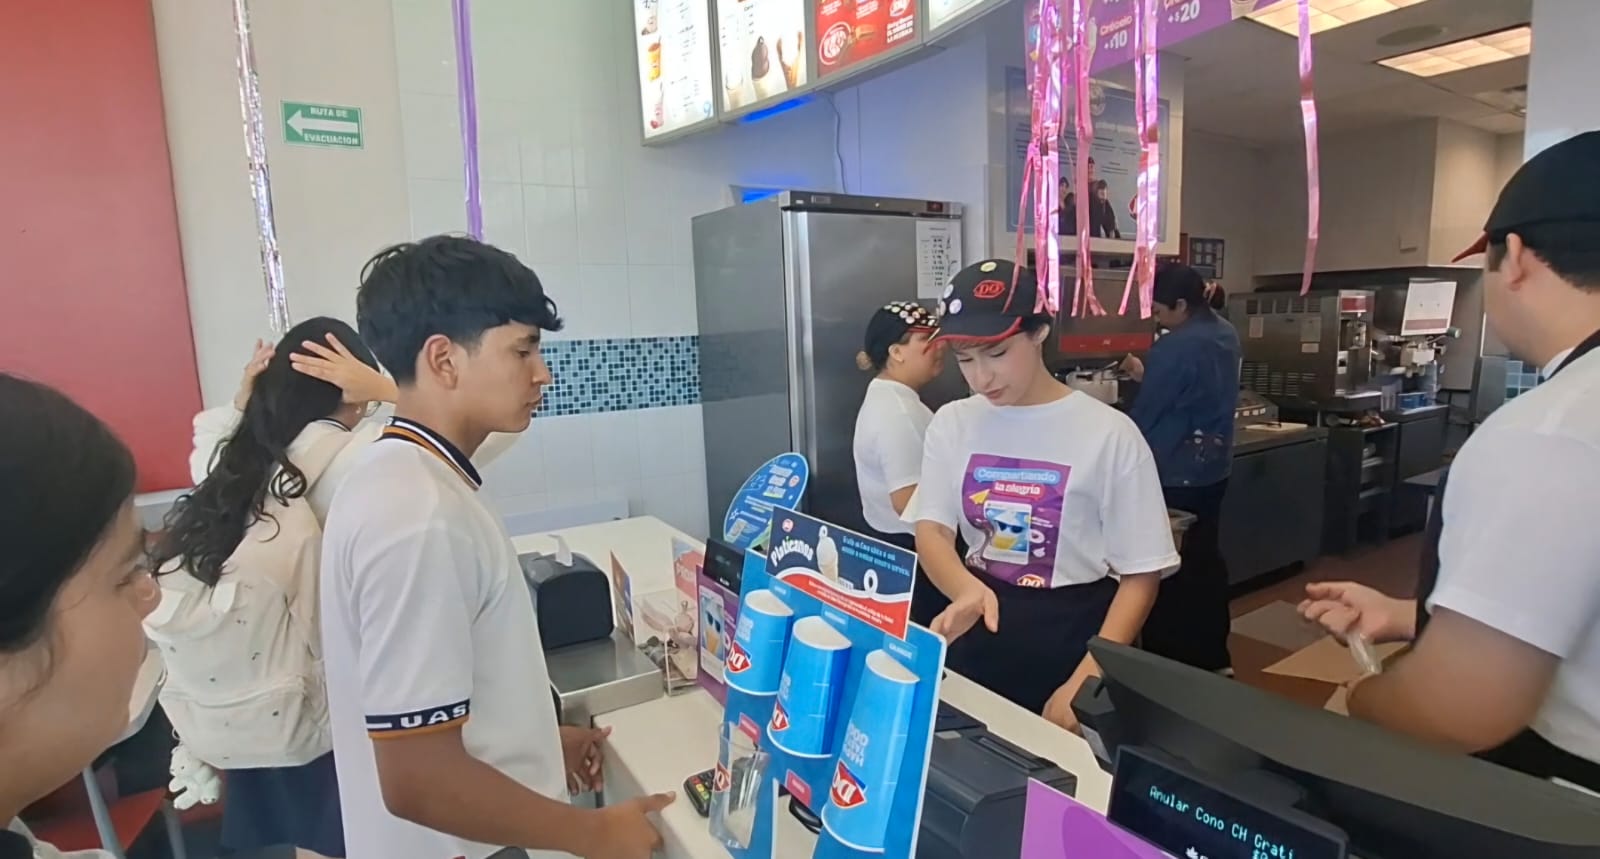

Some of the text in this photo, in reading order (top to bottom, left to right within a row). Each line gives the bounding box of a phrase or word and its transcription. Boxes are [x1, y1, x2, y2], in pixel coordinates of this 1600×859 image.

[310, 106, 348, 118] RUTA DE
[303, 132, 358, 145] EVACUACION
[995, 482, 1004, 491] la
[400, 704, 467, 728] UAS
[1149, 785, 1189, 813] Anular
[1195, 806, 1224, 831] Cono
[1231, 823, 1248, 842] CH
